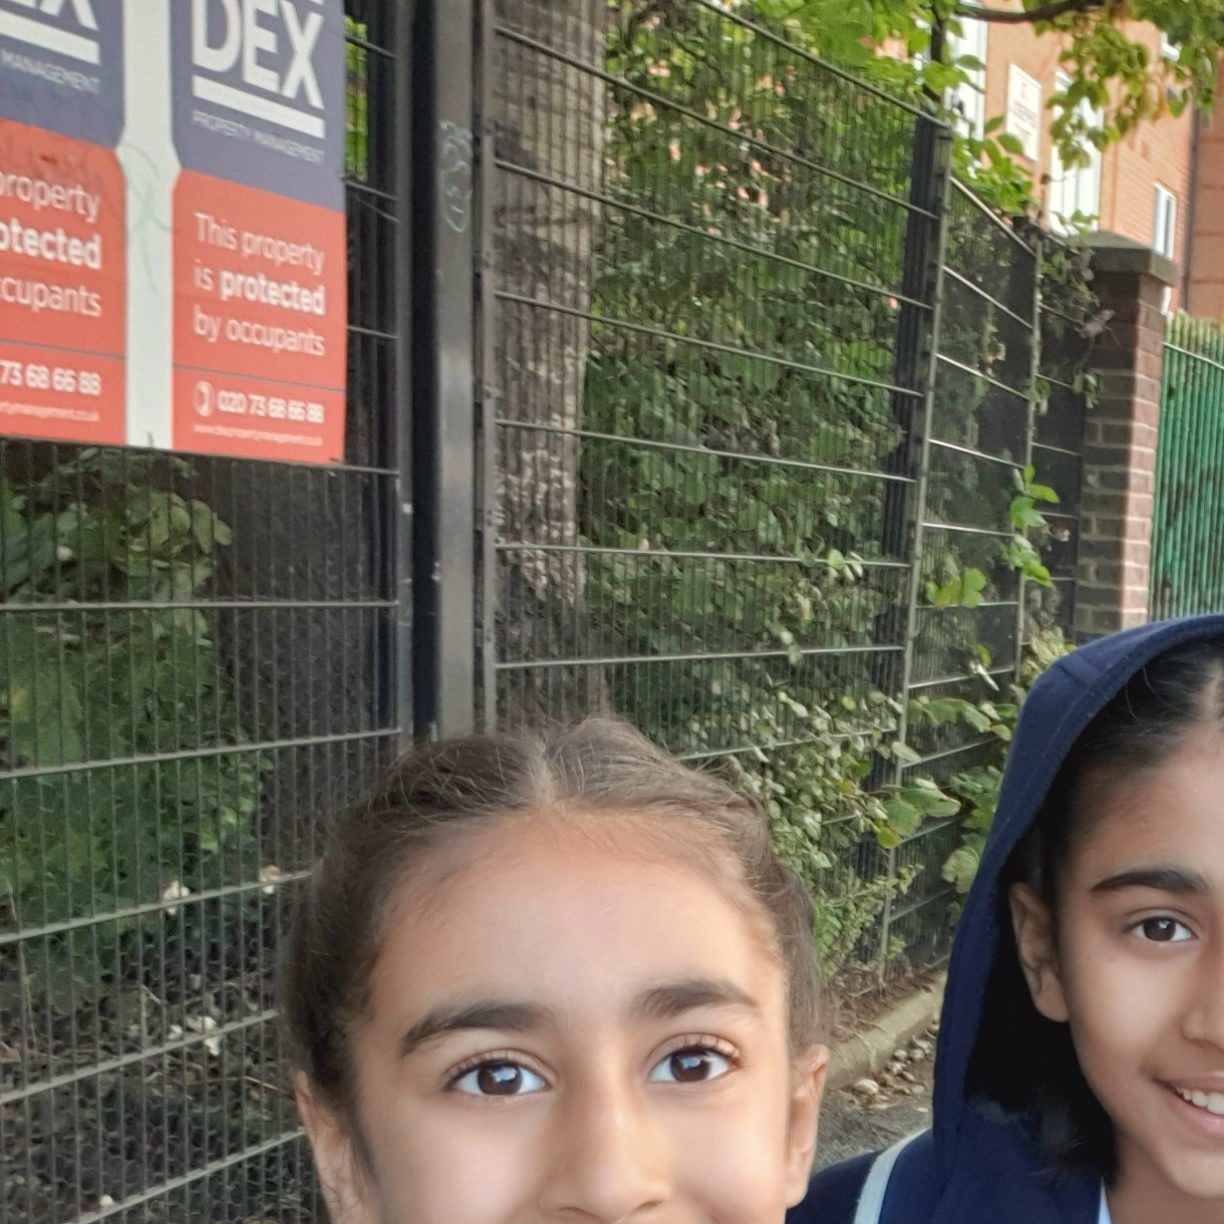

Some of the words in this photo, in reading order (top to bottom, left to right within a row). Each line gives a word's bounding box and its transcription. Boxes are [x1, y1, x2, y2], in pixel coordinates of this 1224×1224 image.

[192, 0, 325, 110] DEX
[0, 170, 100, 223] roperty
[0, 217, 102, 270] otected
[193, 211, 238, 251] This
[240, 231, 325, 276] property
[0, 276, 102, 318] cupants
[194, 257, 214, 292] is
[219, 269, 326, 316] protected
[193, 303, 221, 343] by
[225, 318, 326, 357] occupants
[216, 389, 247, 415] 020
